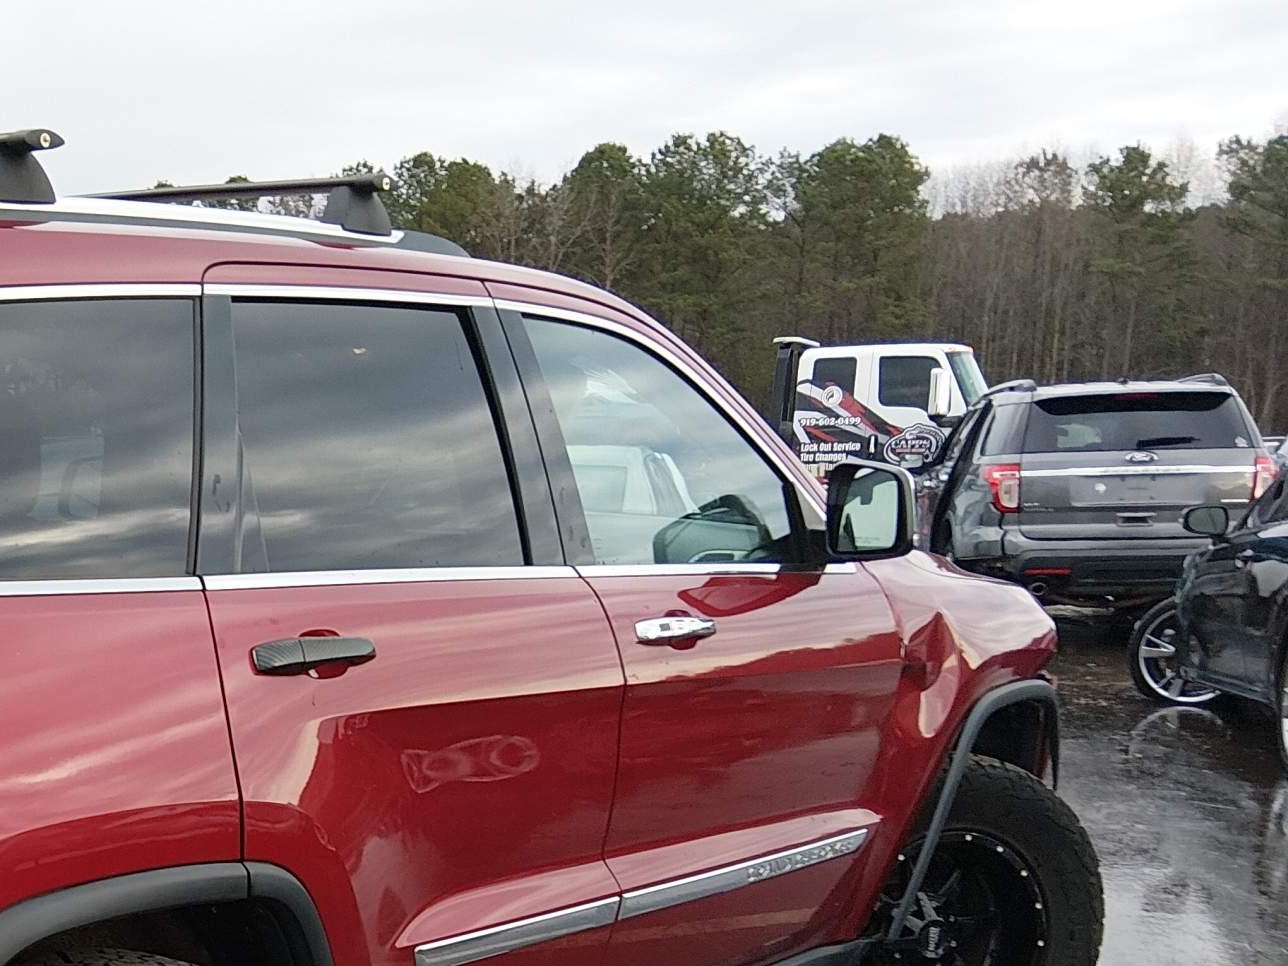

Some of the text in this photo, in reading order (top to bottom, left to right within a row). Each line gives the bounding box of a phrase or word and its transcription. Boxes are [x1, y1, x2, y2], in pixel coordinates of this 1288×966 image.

[800, 416, 862, 427] 919-602-0499
[800, 440, 861, 452] Lock Out Service
[800, 452, 847, 463] Tire Changes
